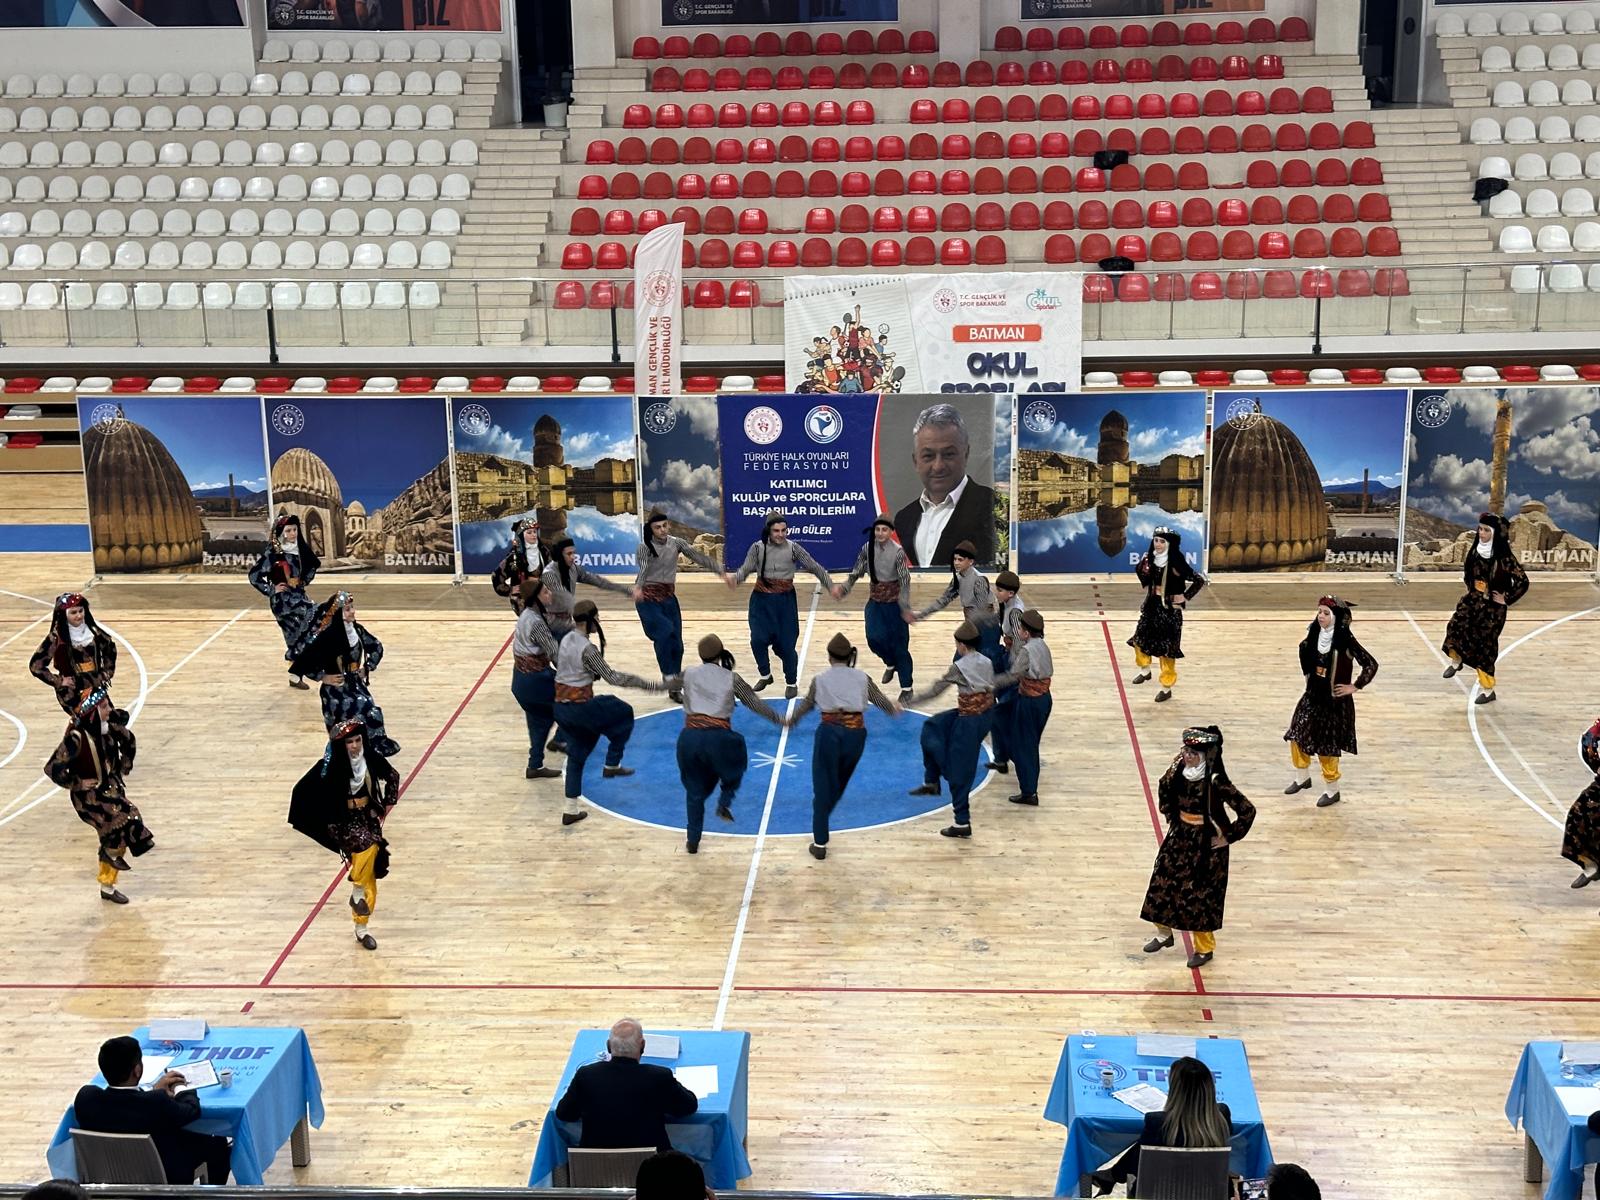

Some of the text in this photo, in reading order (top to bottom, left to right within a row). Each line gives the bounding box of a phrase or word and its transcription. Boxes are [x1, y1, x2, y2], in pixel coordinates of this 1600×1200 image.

[649, 316, 657, 329] VE
[969, 327, 1026, 340] BATMAN
[648, 332, 659, 371] GENÇLİK
[966, 352, 1039, 377] OKUL
[743, 451, 849, 461] TÜRKİYE HALK OYUNLARI
[743, 461, 849, 471] FEDERASYONU
[770, 479, 827, 489] KATILIMCI
[732, 491, 866, 502] KULÜP ve SPORCULARA
[809, 504, 856, 516] DİLERİM
[802, 523, 832, 535] GÜLER
[384, 553, 450, 566] BATMAN
[573, 553, 636, 566] BATMAN
[1325, 549, 1394, 564] BATMAN
[1521, 549, 1593, 564] BATMAN
[188, 1046, 274, 1060] THOF
